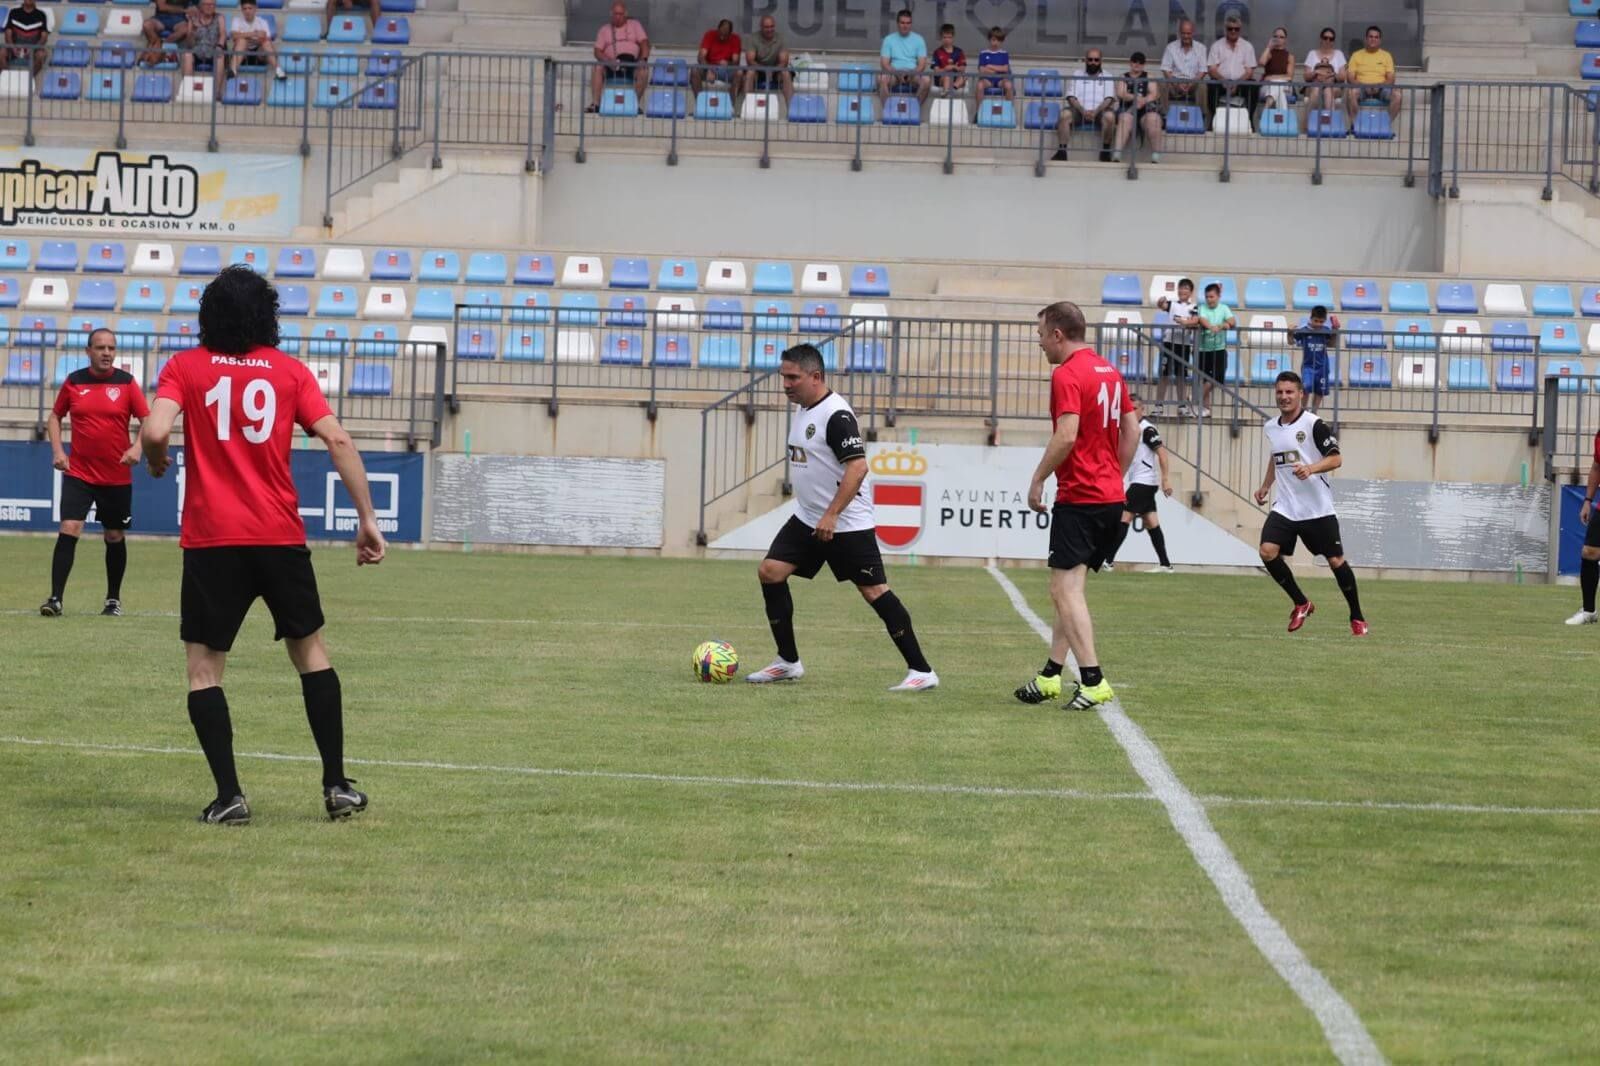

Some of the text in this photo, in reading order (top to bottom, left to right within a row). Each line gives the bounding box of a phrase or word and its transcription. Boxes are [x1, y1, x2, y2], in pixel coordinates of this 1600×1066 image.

[99, 218, 115, 228] DE
[186, 221, 194, 230] Y
[211, 355, 273, 369] PASCUAL
[205, 376, 277, 444] 19
[1096, 381, 1121, 428] 14
[0, 505, 31, 521] stica
[940, 507, 1145, 533] PUERTOO
